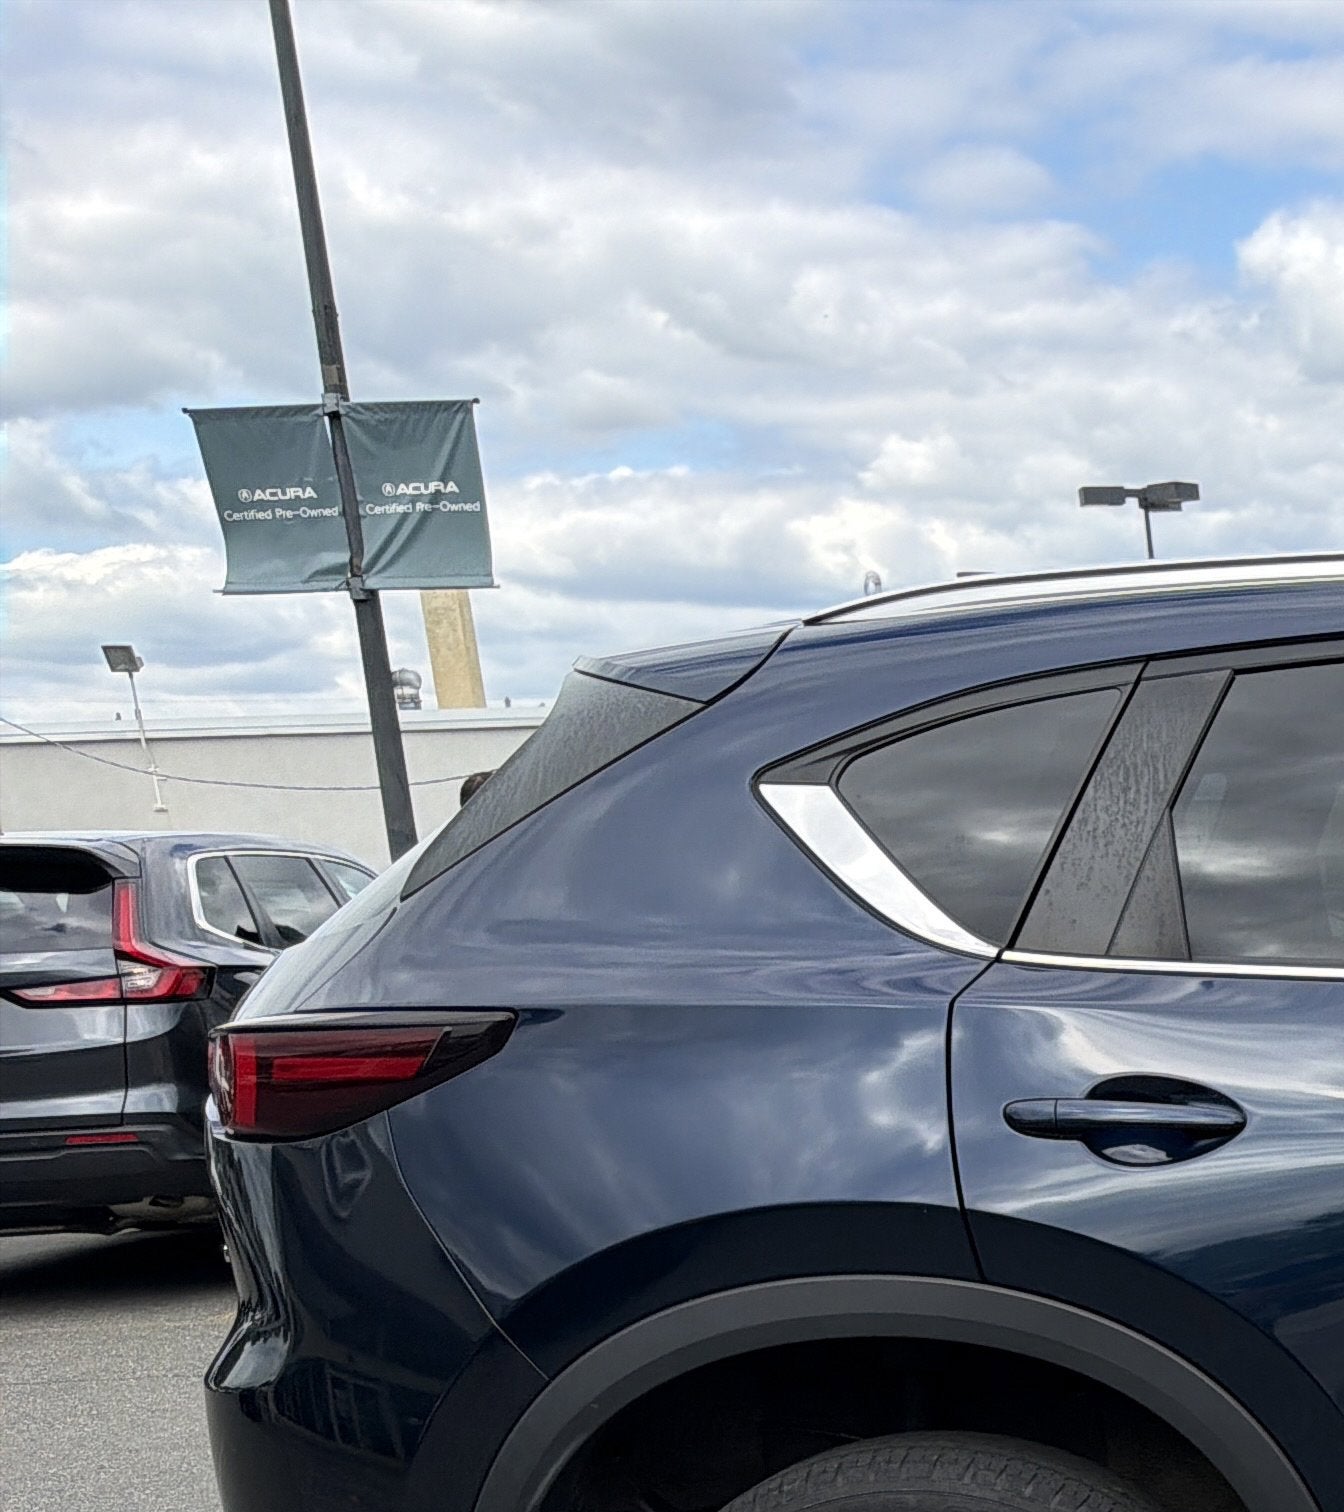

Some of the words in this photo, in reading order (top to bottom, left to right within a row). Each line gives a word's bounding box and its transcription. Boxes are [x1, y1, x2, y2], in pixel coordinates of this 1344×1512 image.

[252, 486, 319, 502] ACURA
[396, 480, 460, 497] ACURA
[223, 507, 273, 523] Certified
[275, 505, 340, 521] Pre-Owned
[365, 501, 413, 516] Certified
[415, 500, 482, 514] Pre-Owned
